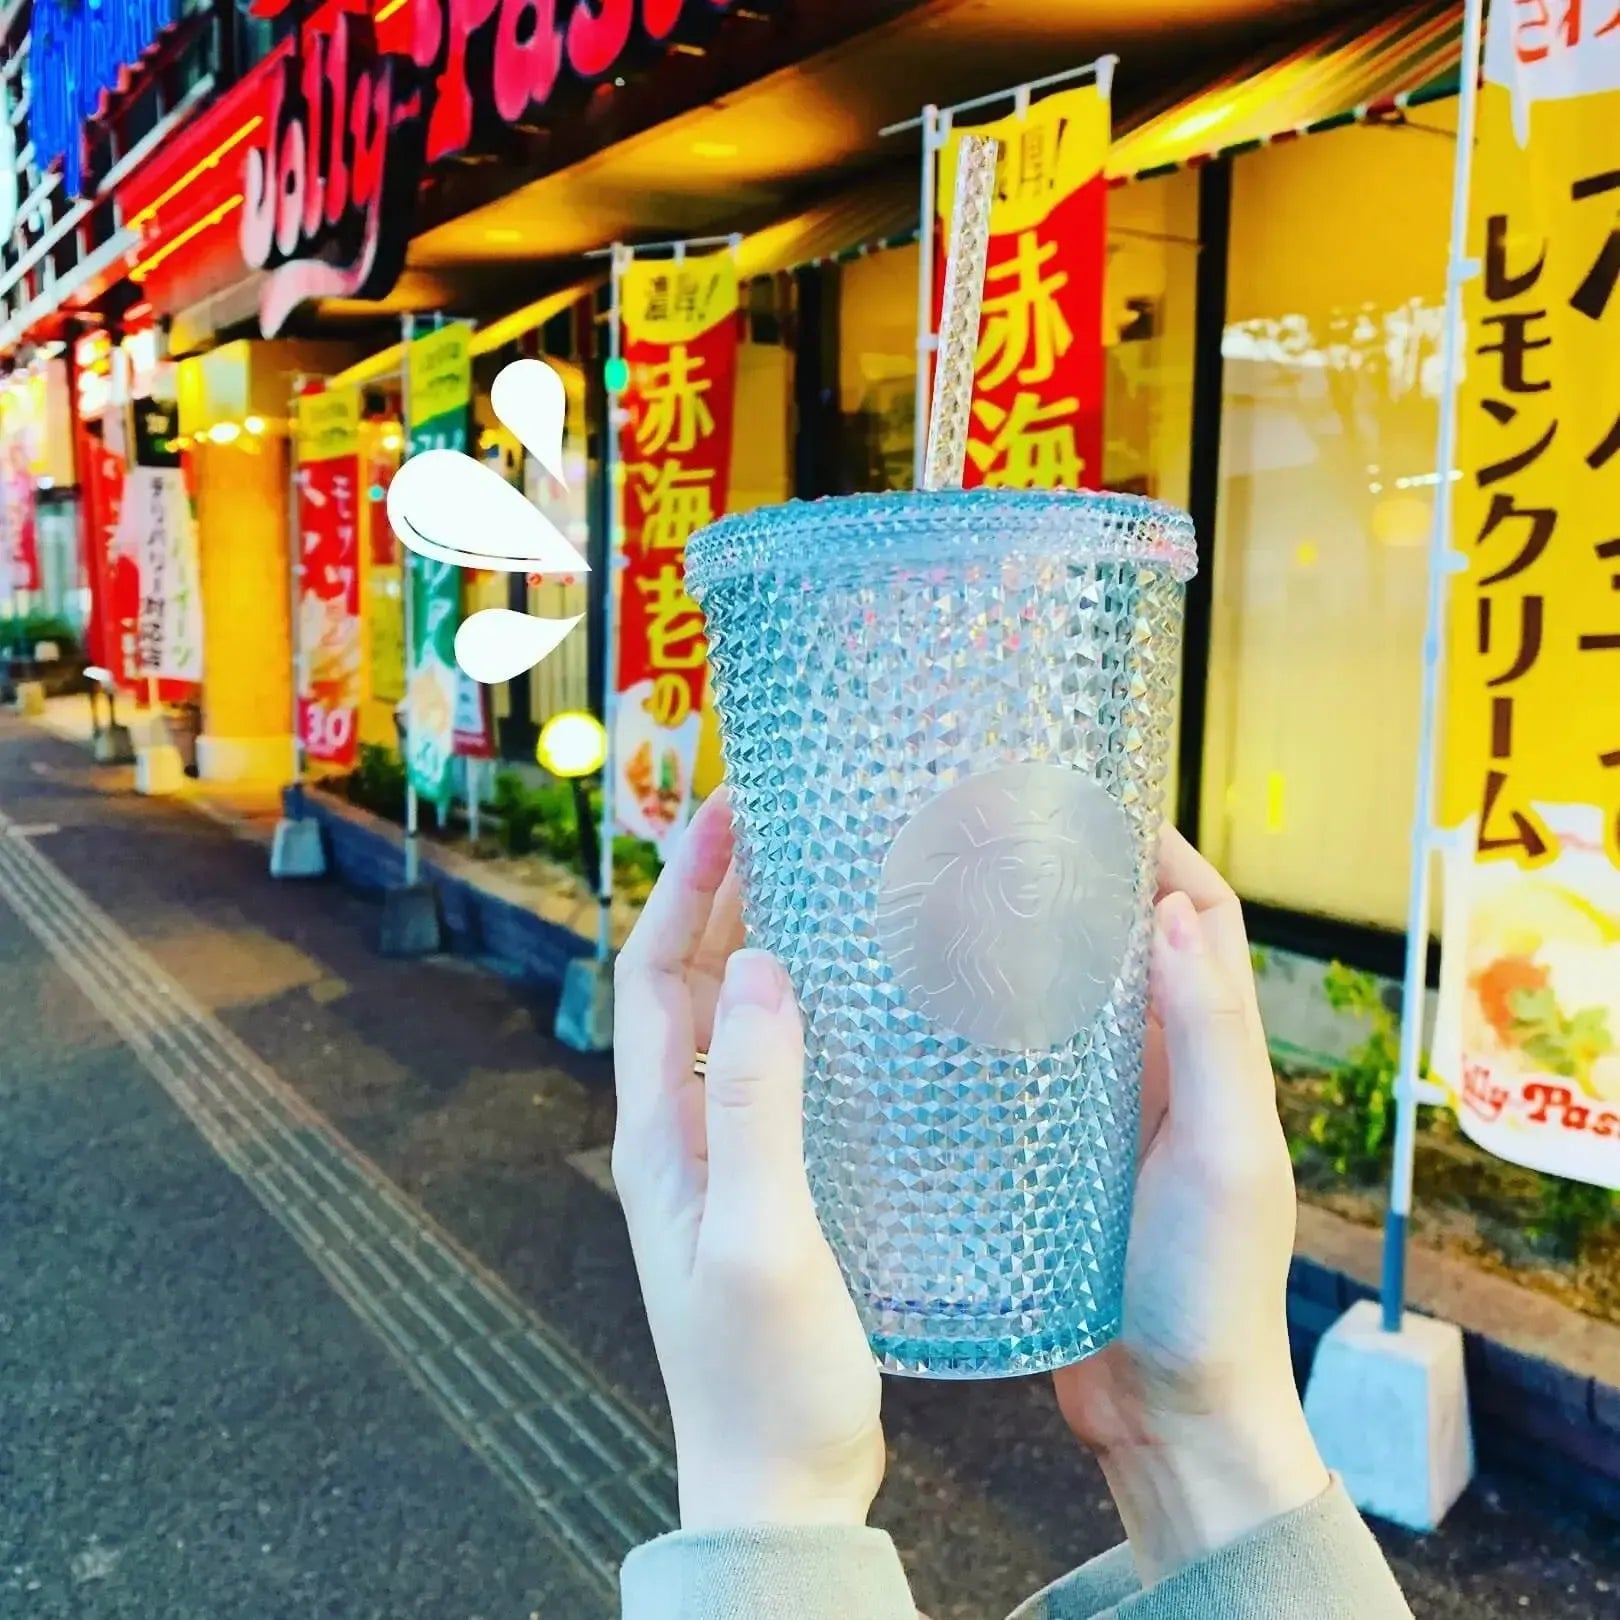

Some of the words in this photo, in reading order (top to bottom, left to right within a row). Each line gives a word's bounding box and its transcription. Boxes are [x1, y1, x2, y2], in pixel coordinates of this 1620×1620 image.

[634, 341, 717, 730] 赤海老の
[1475, 214, 1558, 860] レモンクリーム
[1523, 1083, 1620, 1137] Pas
